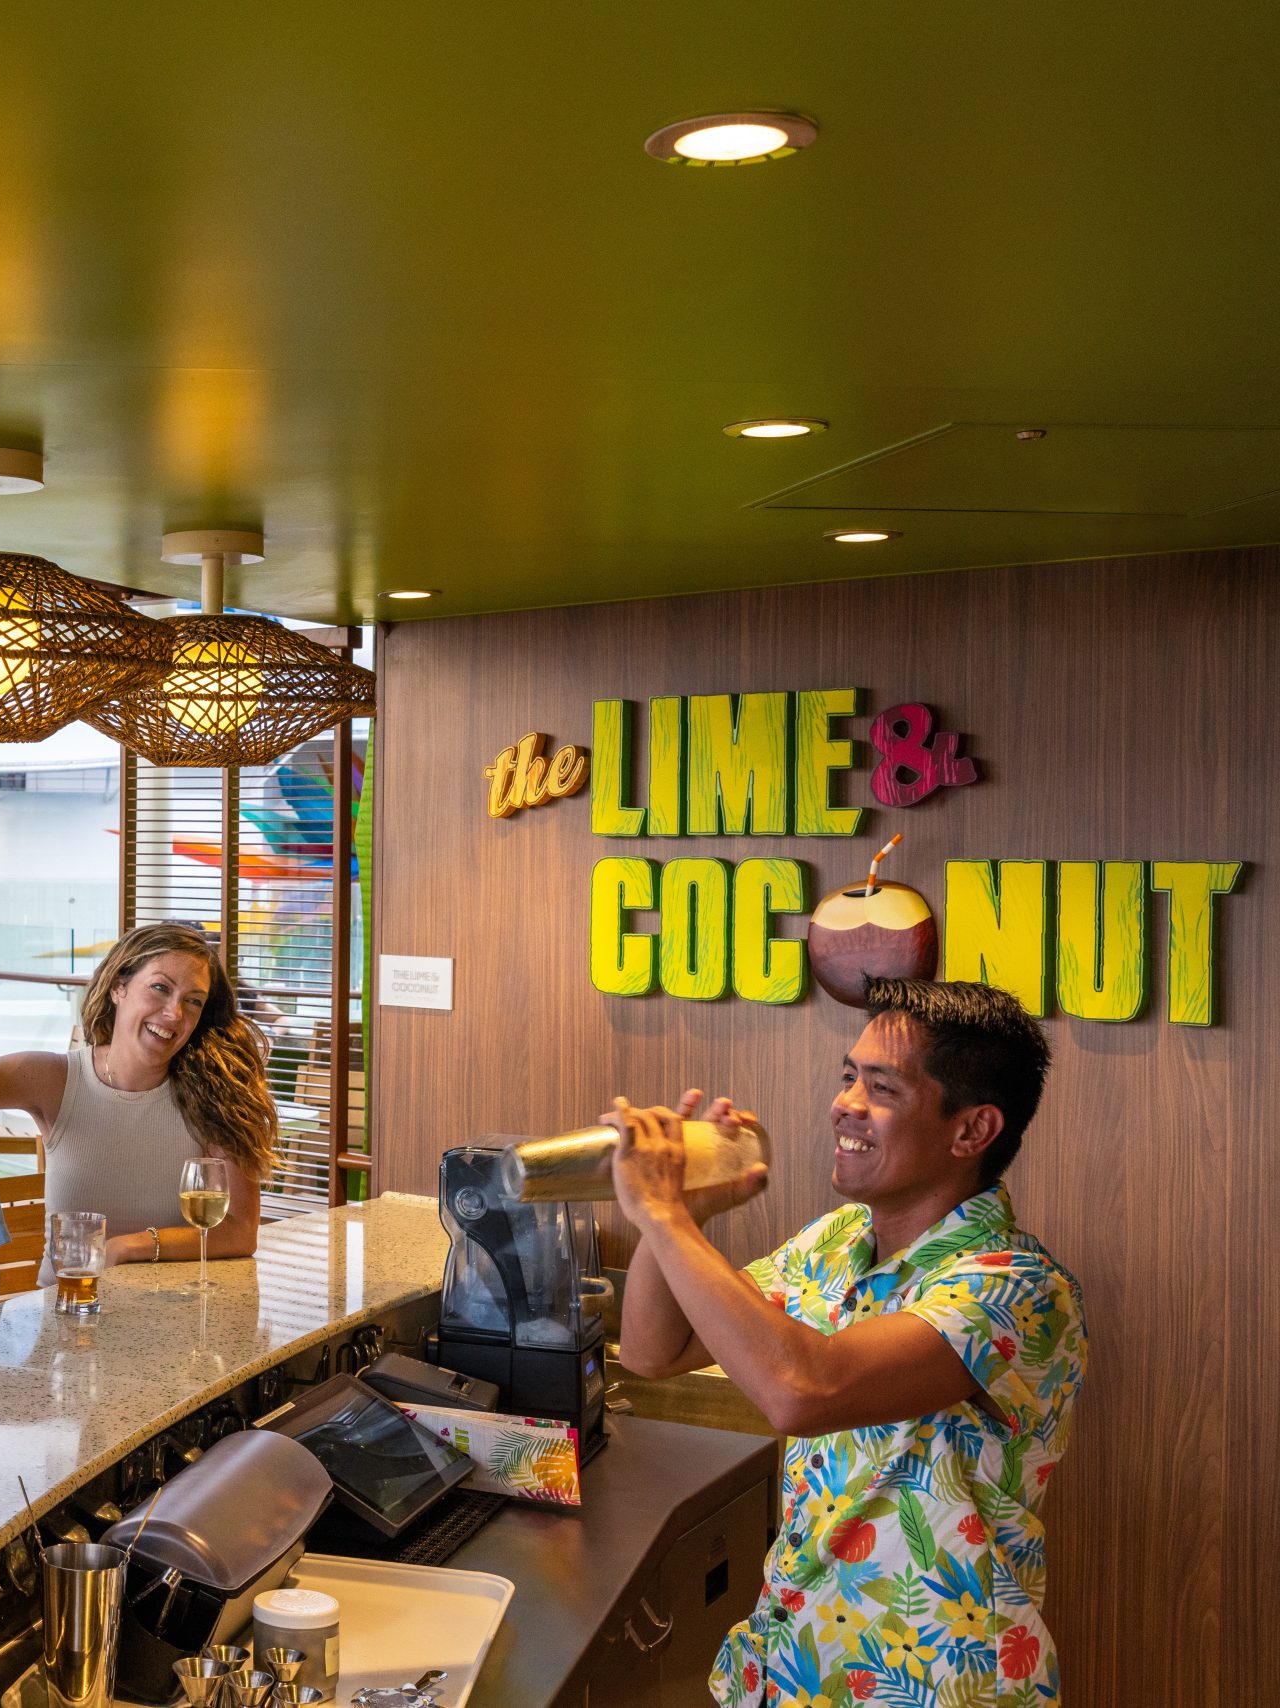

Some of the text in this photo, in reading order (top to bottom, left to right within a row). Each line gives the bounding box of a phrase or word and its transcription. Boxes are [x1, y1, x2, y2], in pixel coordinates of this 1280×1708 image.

[484, 687, 979, 838] the LIME &
[392, 982, 440, 994] COCONUT
